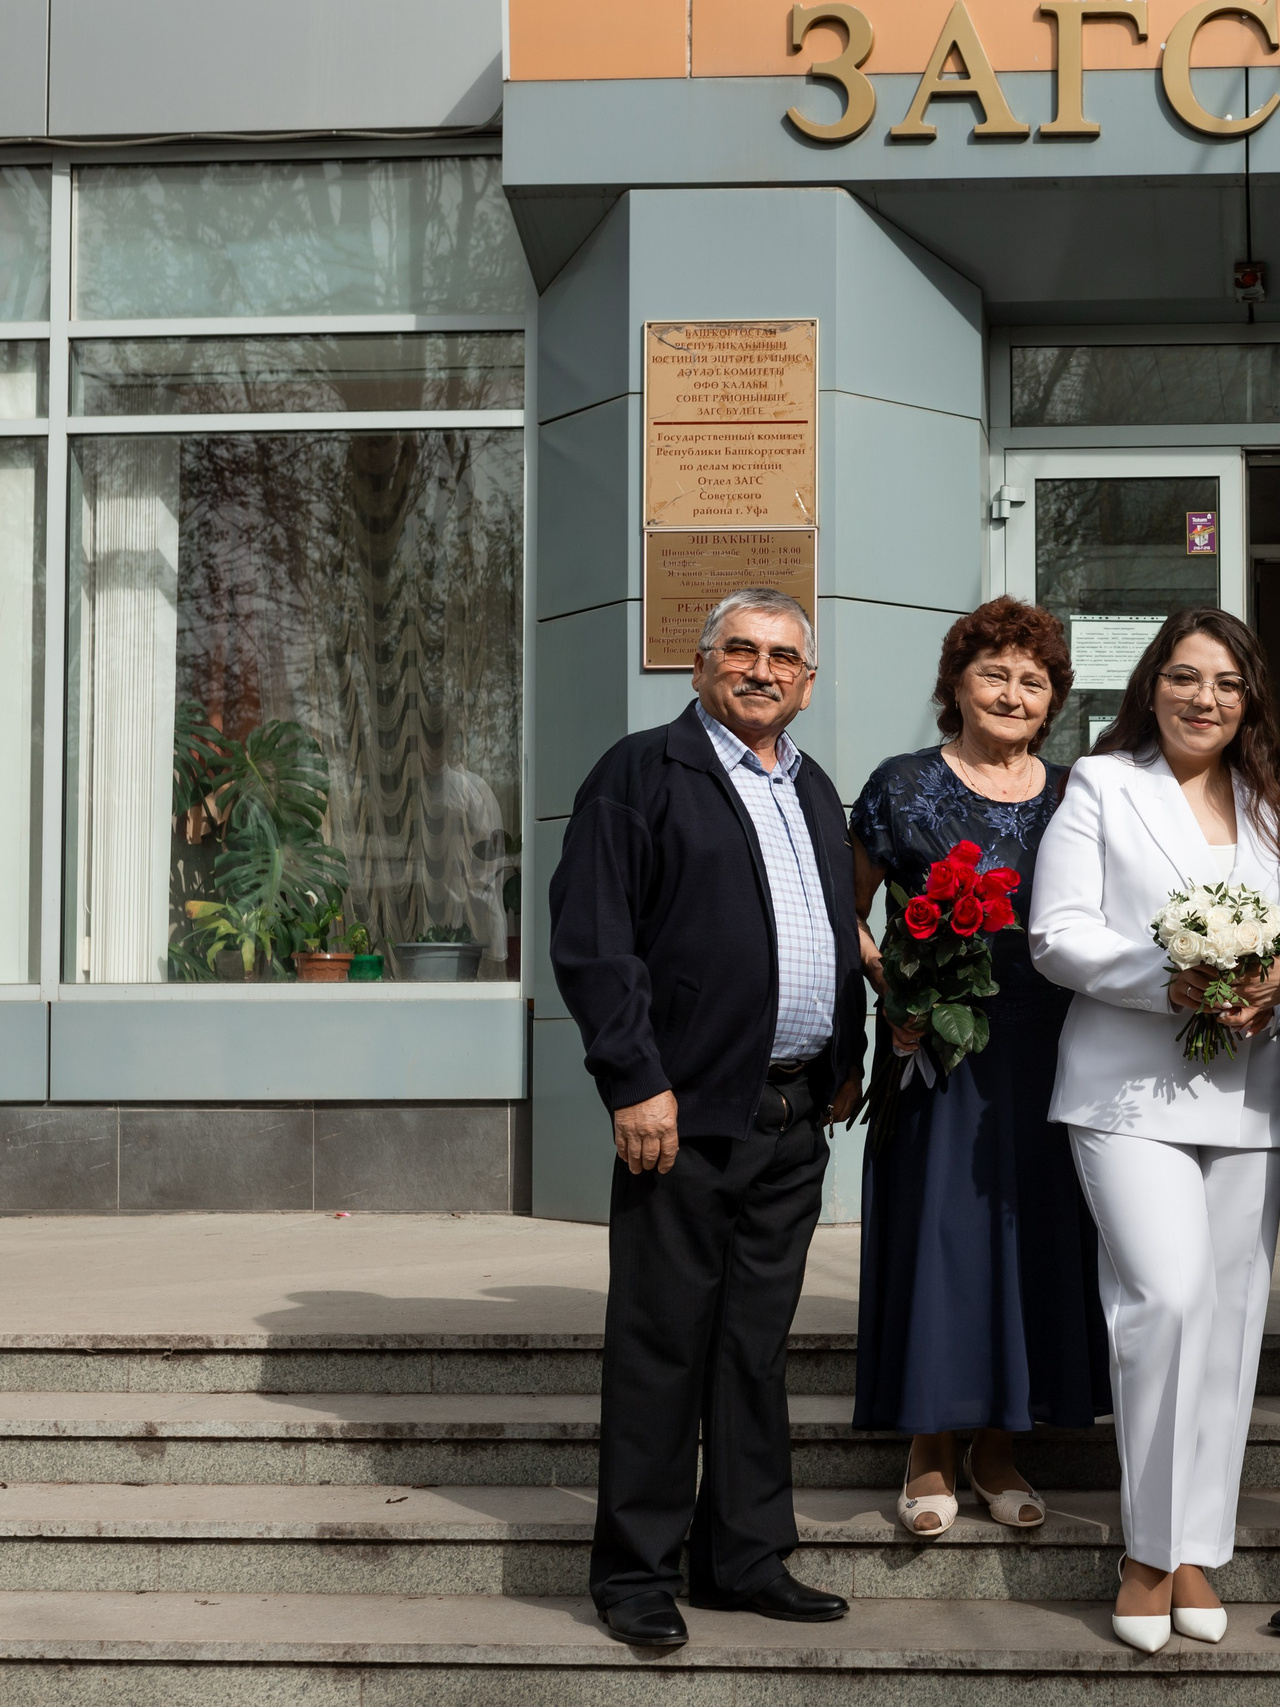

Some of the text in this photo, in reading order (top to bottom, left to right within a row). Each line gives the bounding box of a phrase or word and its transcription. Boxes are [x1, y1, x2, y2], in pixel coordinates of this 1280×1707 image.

[658, 433, 754, 443] Государственный
[656, 447, 805, 458] Республики Башкортостан
[698, 477, 763, 486] Отдел ЗАГС
[700, 492, 762, 500] Советского
[693, 506, 732, 517] района
[746, 506, 768, 517] Уфа
[688, 535, 708, 544] ЭШ
[751, 547, 769, 555] 9.00
[678, 603, 719, 612] РЕЖИ
[662, 617, 698, 626] Вторник
[661, 627, 700, 636] Перерыв
